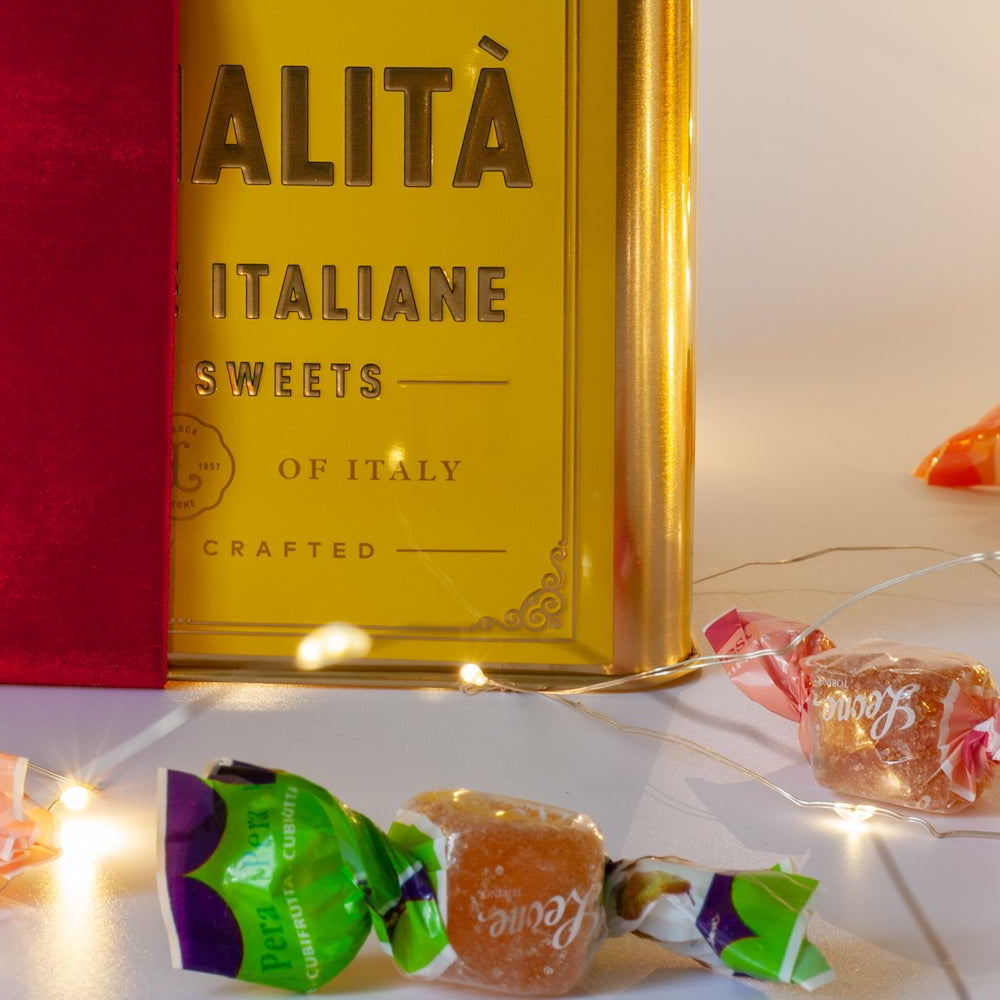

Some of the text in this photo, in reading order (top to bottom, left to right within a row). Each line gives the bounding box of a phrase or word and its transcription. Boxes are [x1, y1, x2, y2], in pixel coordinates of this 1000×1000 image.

[211, 262, 506, 323] ITALIANE
[194, 360, 382, 399] SWEETS
[171, 425, 199, 437] ARCA
[278, 457, 462, 483] OF ITALY
[202, 539, 376, 560] CRAFTED
[813, 684, 921, 740] Leone
[256, 905, 292, 973] Pera
[477, 882, 602, 951] Leone
